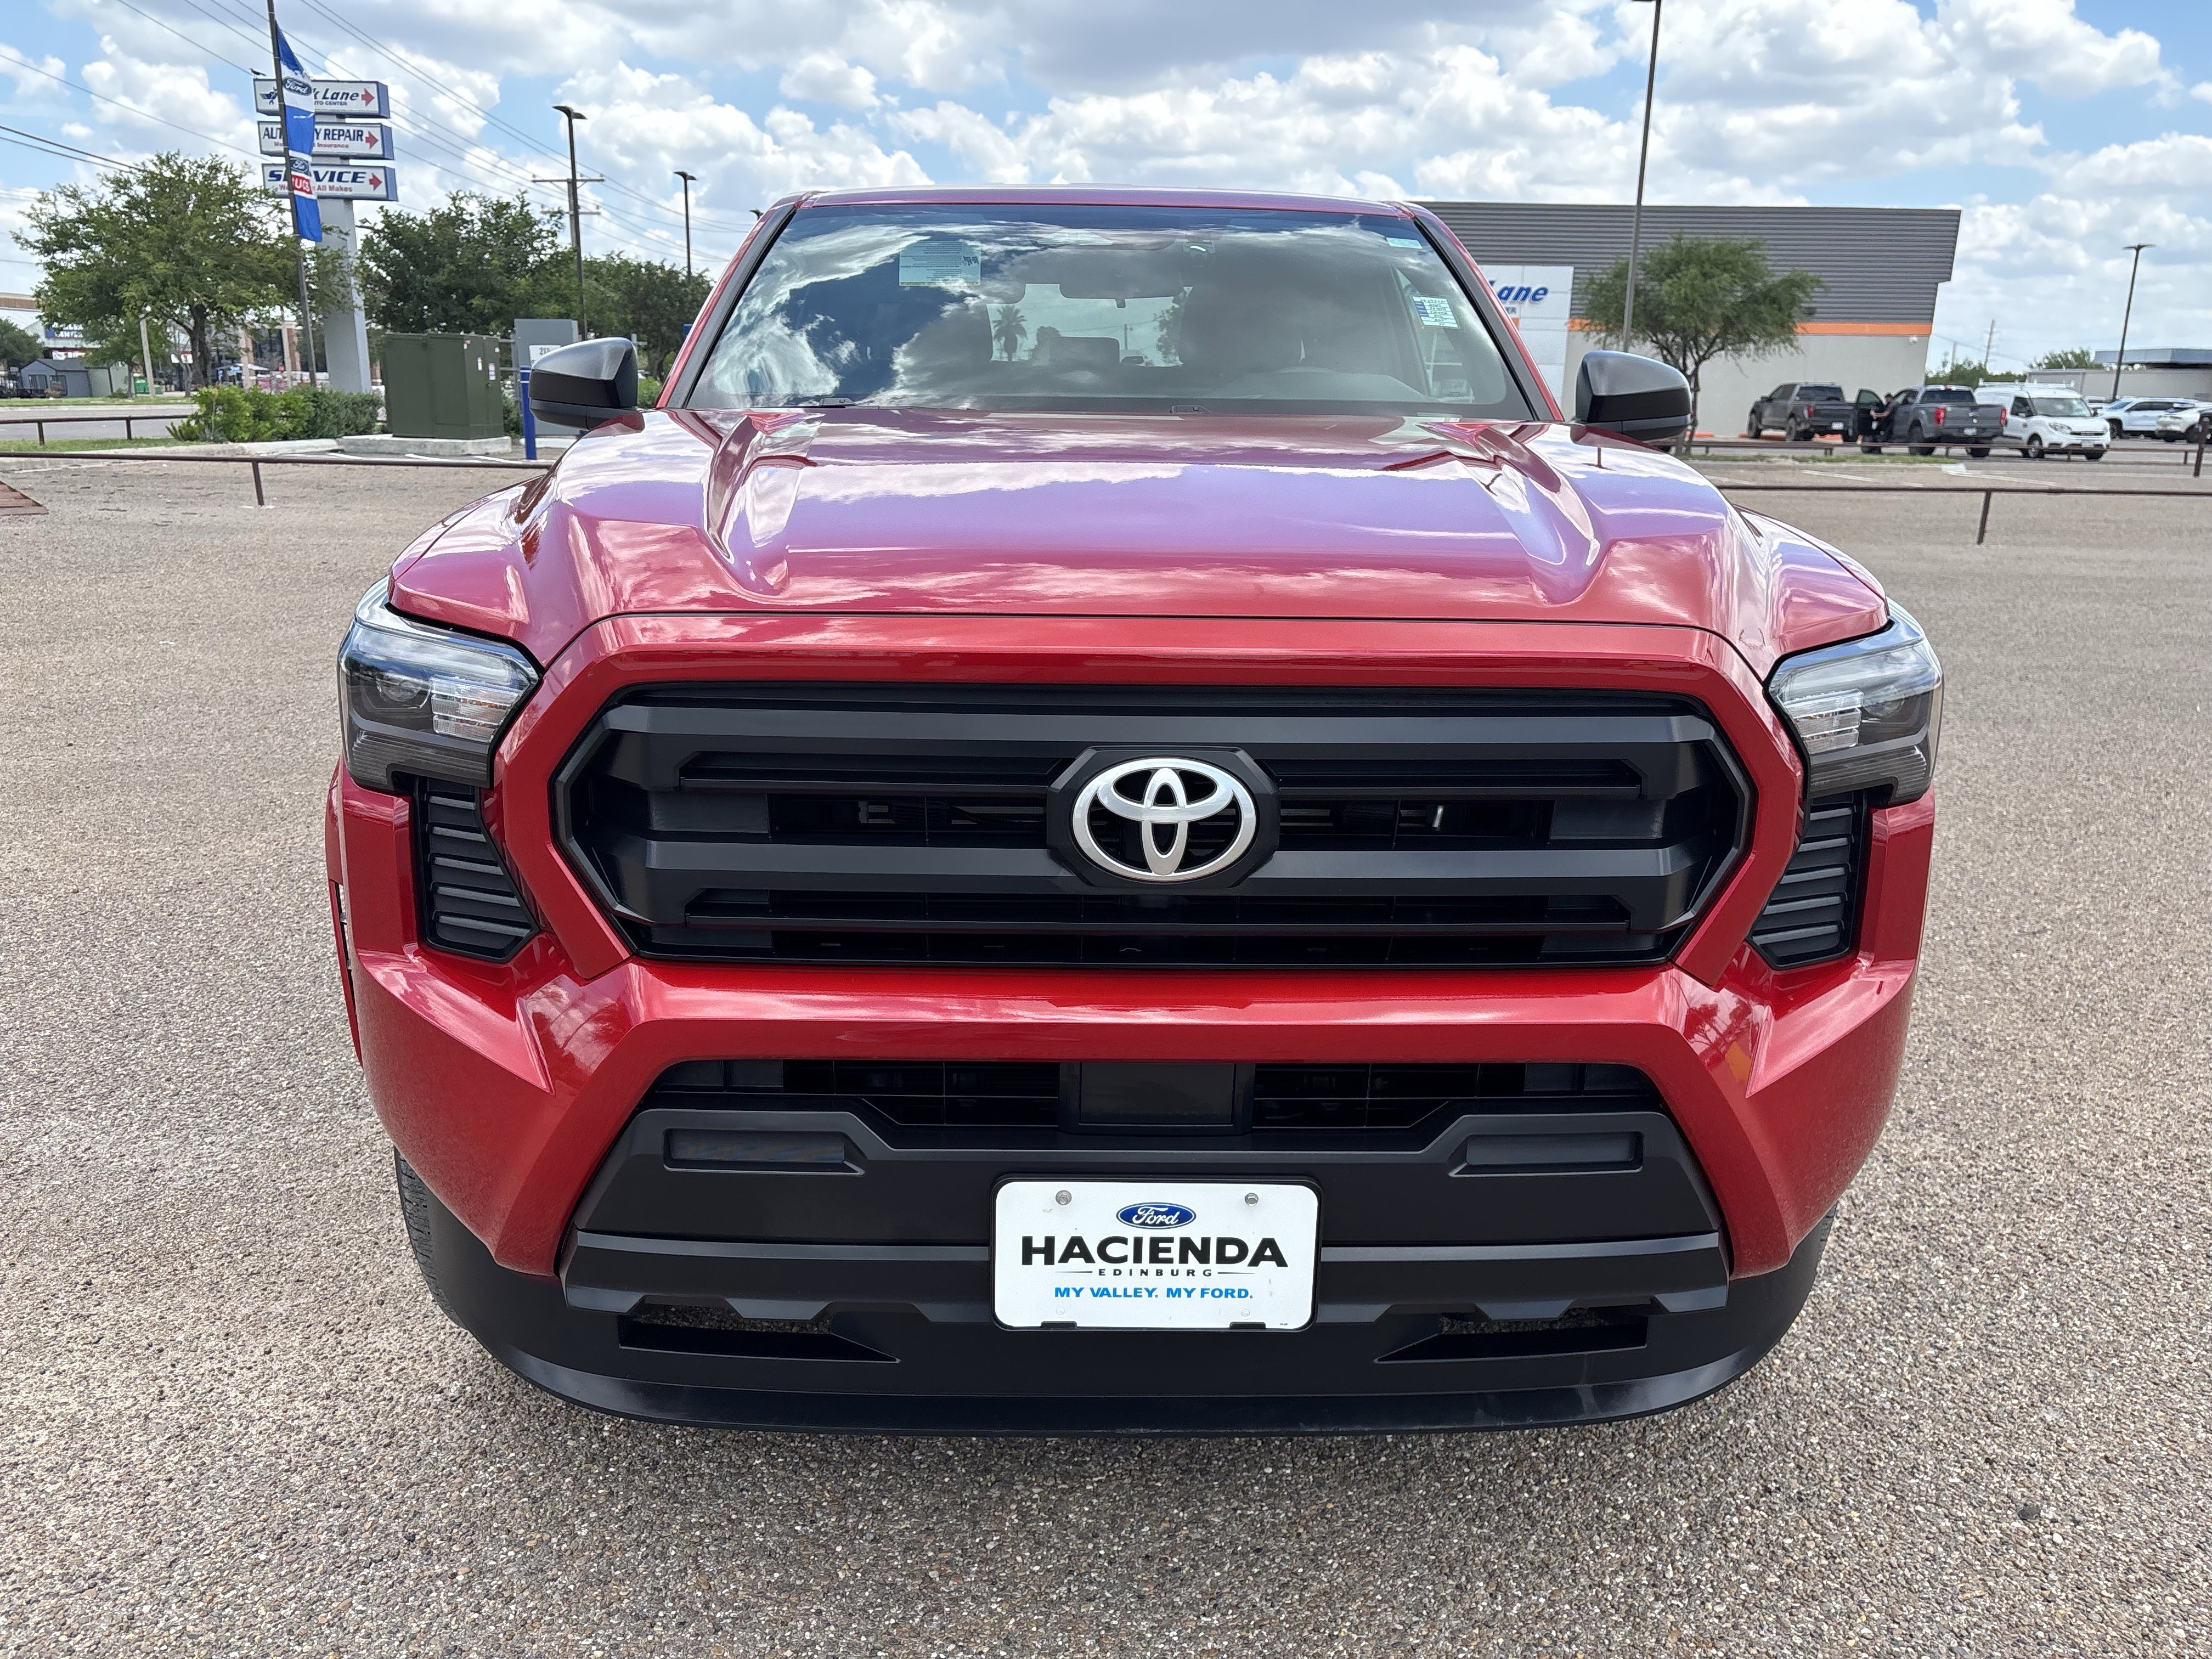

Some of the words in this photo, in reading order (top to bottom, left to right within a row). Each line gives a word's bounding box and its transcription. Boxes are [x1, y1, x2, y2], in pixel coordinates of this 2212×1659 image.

[284, 78, 308, 93] Ford
[321, 88, 359, 101] Lane
[324, 128, 364, 142] REPAIR
[1488, 280, 1548, 302] ane
[1132, 1205, 1181, 1226] Ford
[1022, 1235, 1289, 1268] HACIENDA
[1098, 1268, 1213, 1277] EDINBURG
[1054, 1287, 1085, 1298] MY
[1089, 1287, 1158, 1299] VALLEY.
[1166, 1288, 1197, 1299] MY
[1200, 1288, 1253, 1299] FORD.
